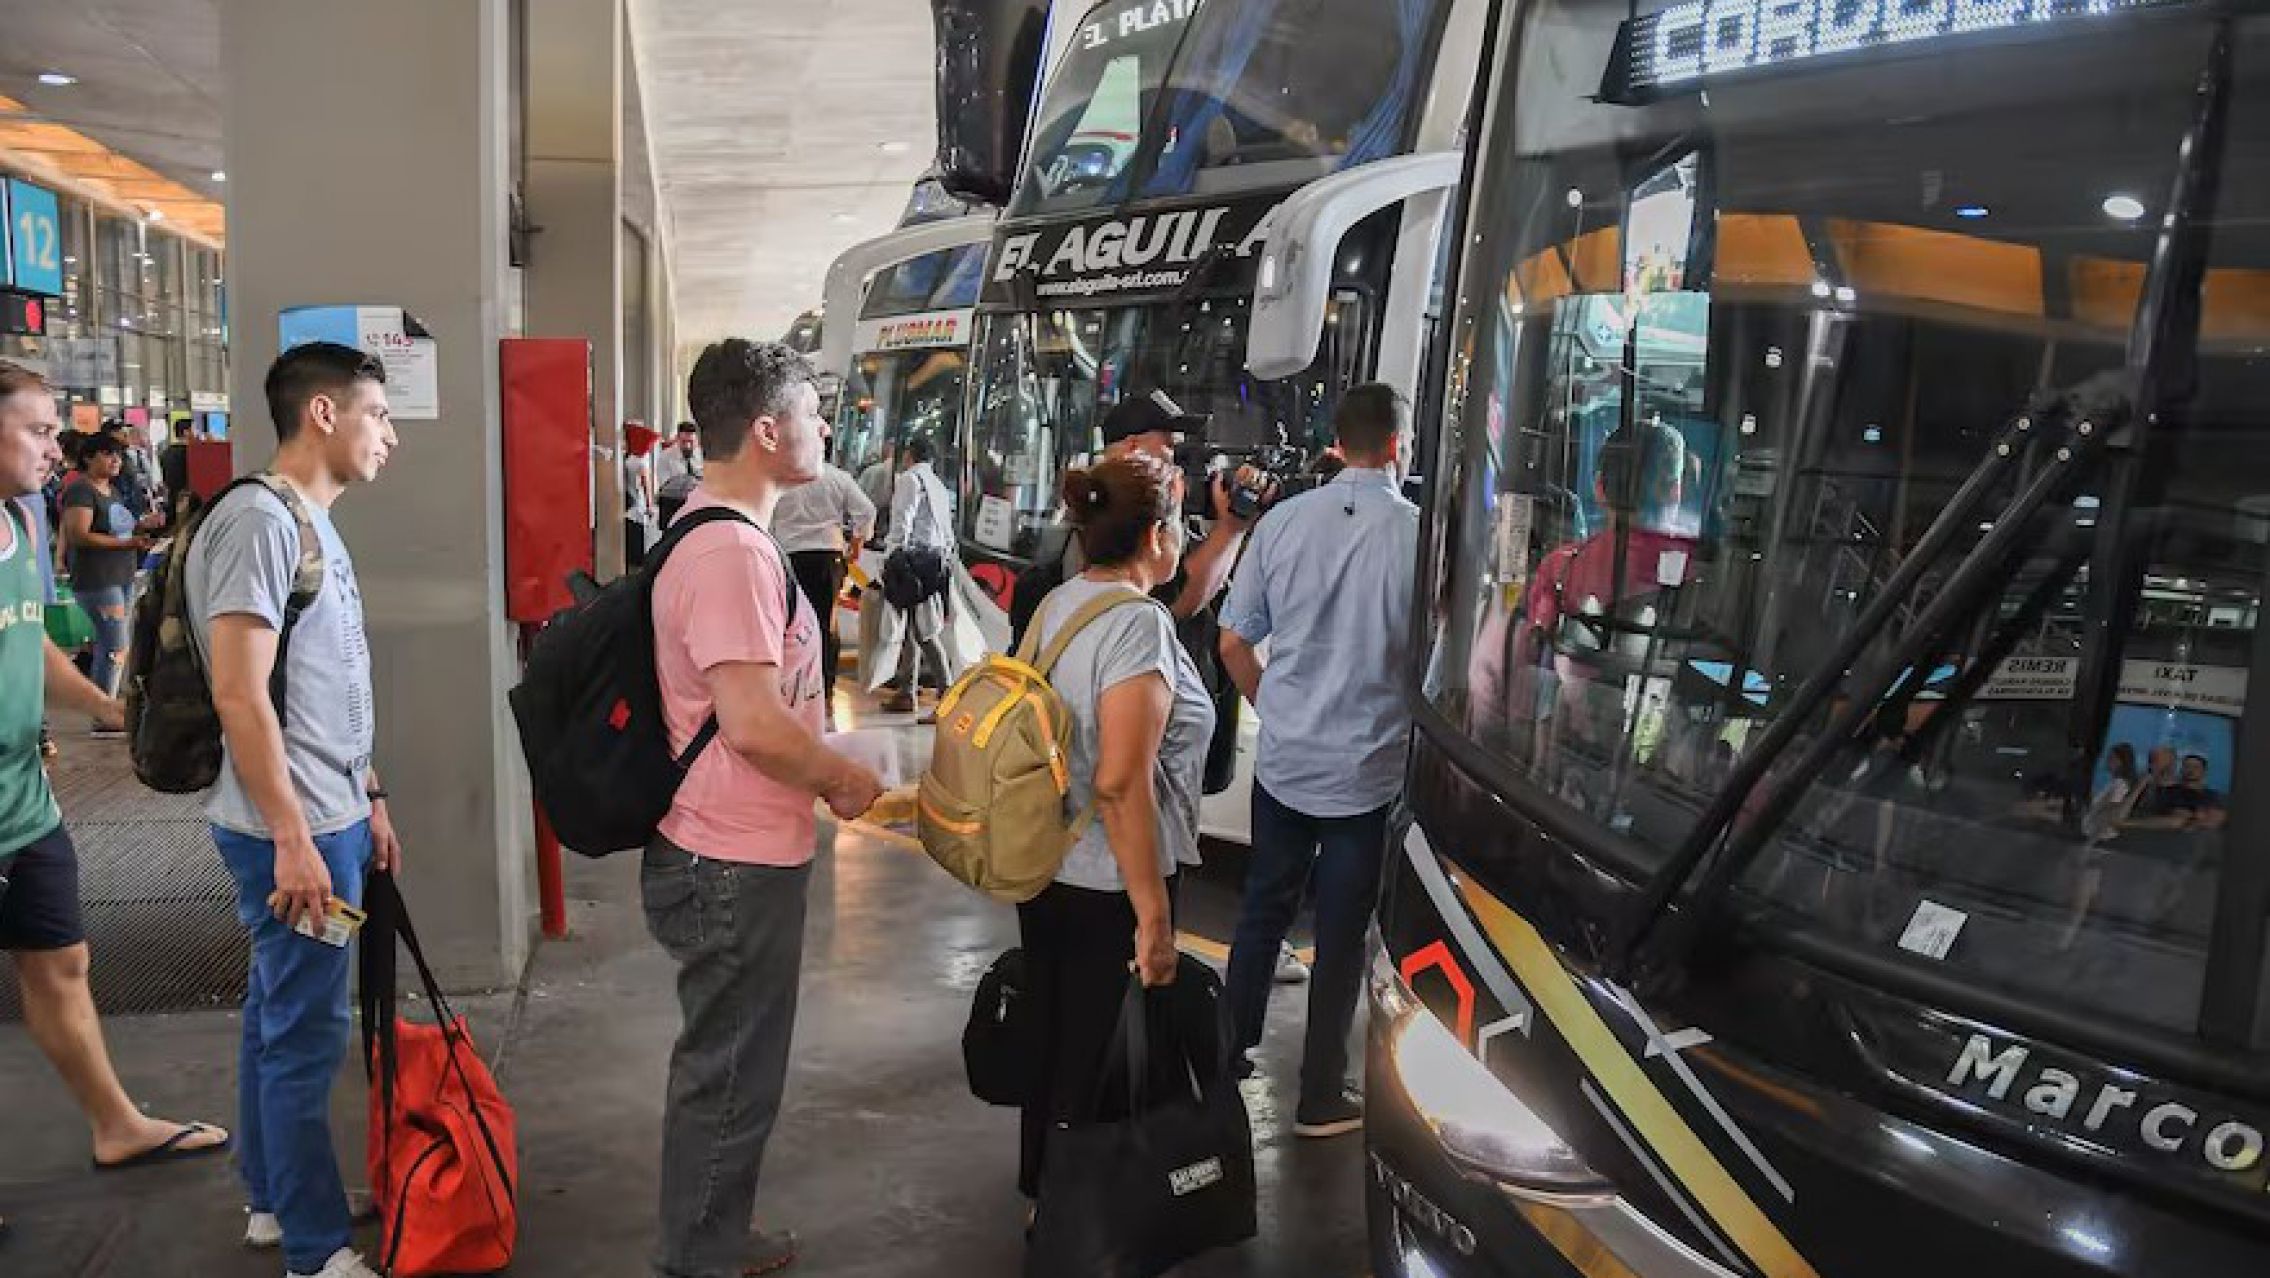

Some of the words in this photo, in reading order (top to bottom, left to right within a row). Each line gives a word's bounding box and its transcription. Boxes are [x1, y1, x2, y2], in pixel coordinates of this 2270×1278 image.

[20, 211, 57, 270] 12
[992, 231, 1041, 283] EL
[1946, 1033, 2270, 1192] Marco
